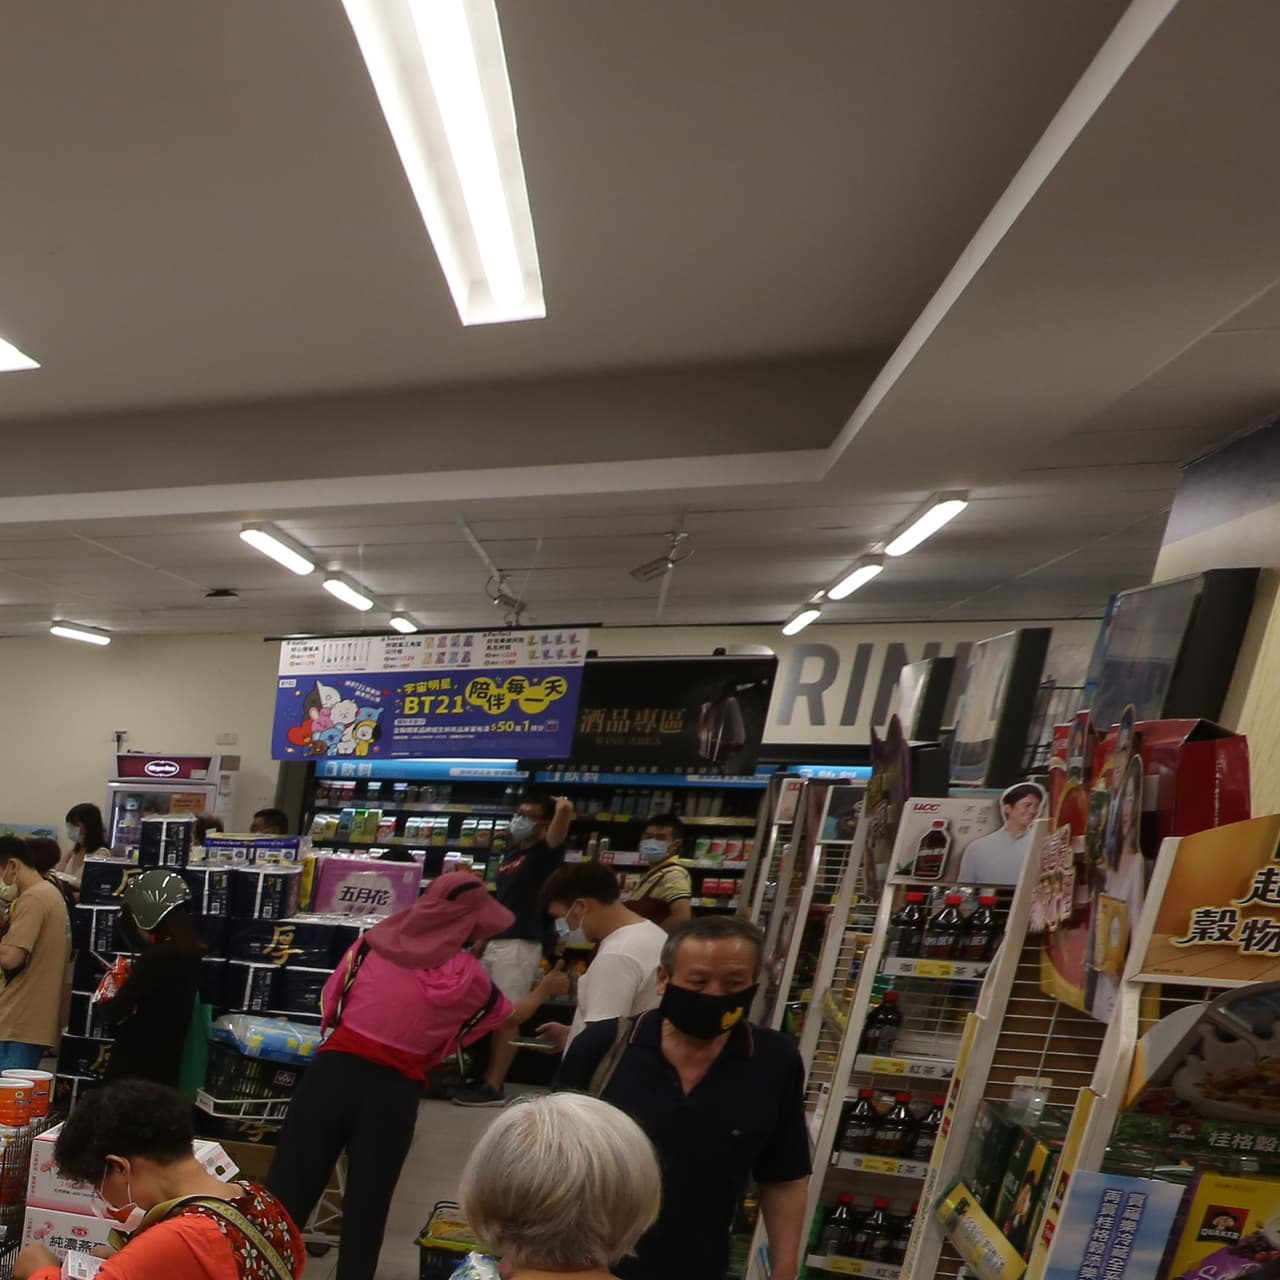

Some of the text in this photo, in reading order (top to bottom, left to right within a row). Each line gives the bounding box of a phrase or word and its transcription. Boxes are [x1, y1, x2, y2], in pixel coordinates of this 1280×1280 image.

[403, 697, 465, 715] BT21
[580, 708, 687, 735] 酒品專區
[912, 802, 941, 812] UCC
[339, 886, 393, 906] 五月花
[1201, 1227, 1241, 1241] QUAKER
